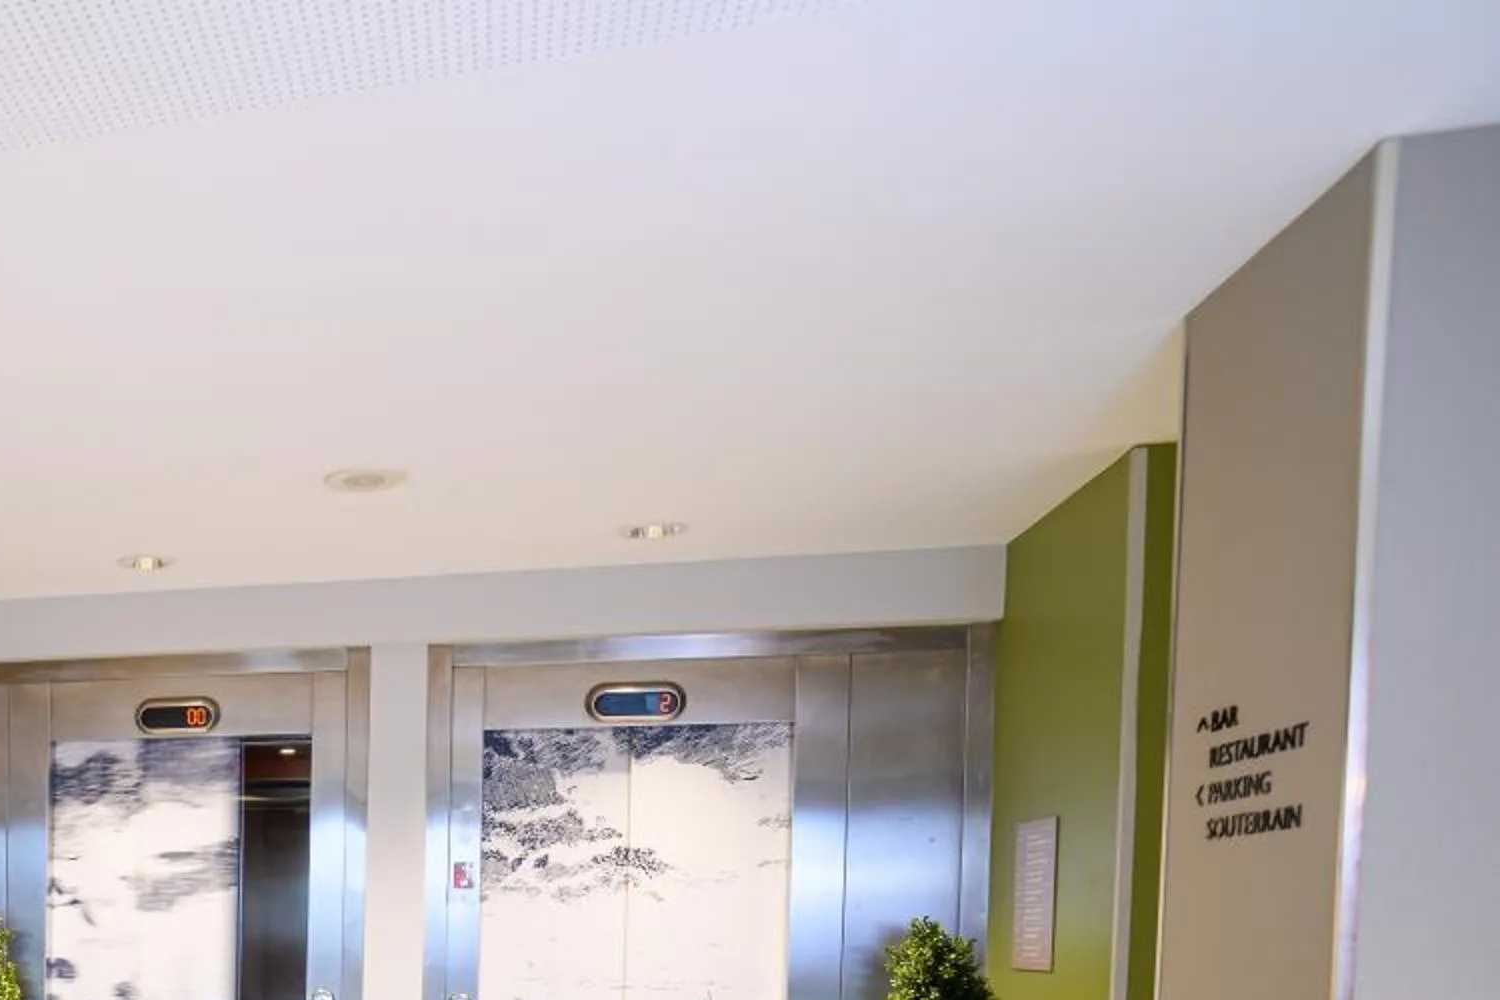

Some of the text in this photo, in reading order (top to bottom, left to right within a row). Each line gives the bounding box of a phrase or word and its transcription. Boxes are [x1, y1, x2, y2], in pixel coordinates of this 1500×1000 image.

[187, 708, 206, 724] 00
[660, 693, 671, 713] 2
[1210, 705, 1239, 733] BAR
[1209, 720, 1310, 769] RESTAURANT
[1207, 770, 1273, 805] PARKING
[1205, 802, 1303, 840] SOUTERRAIN
